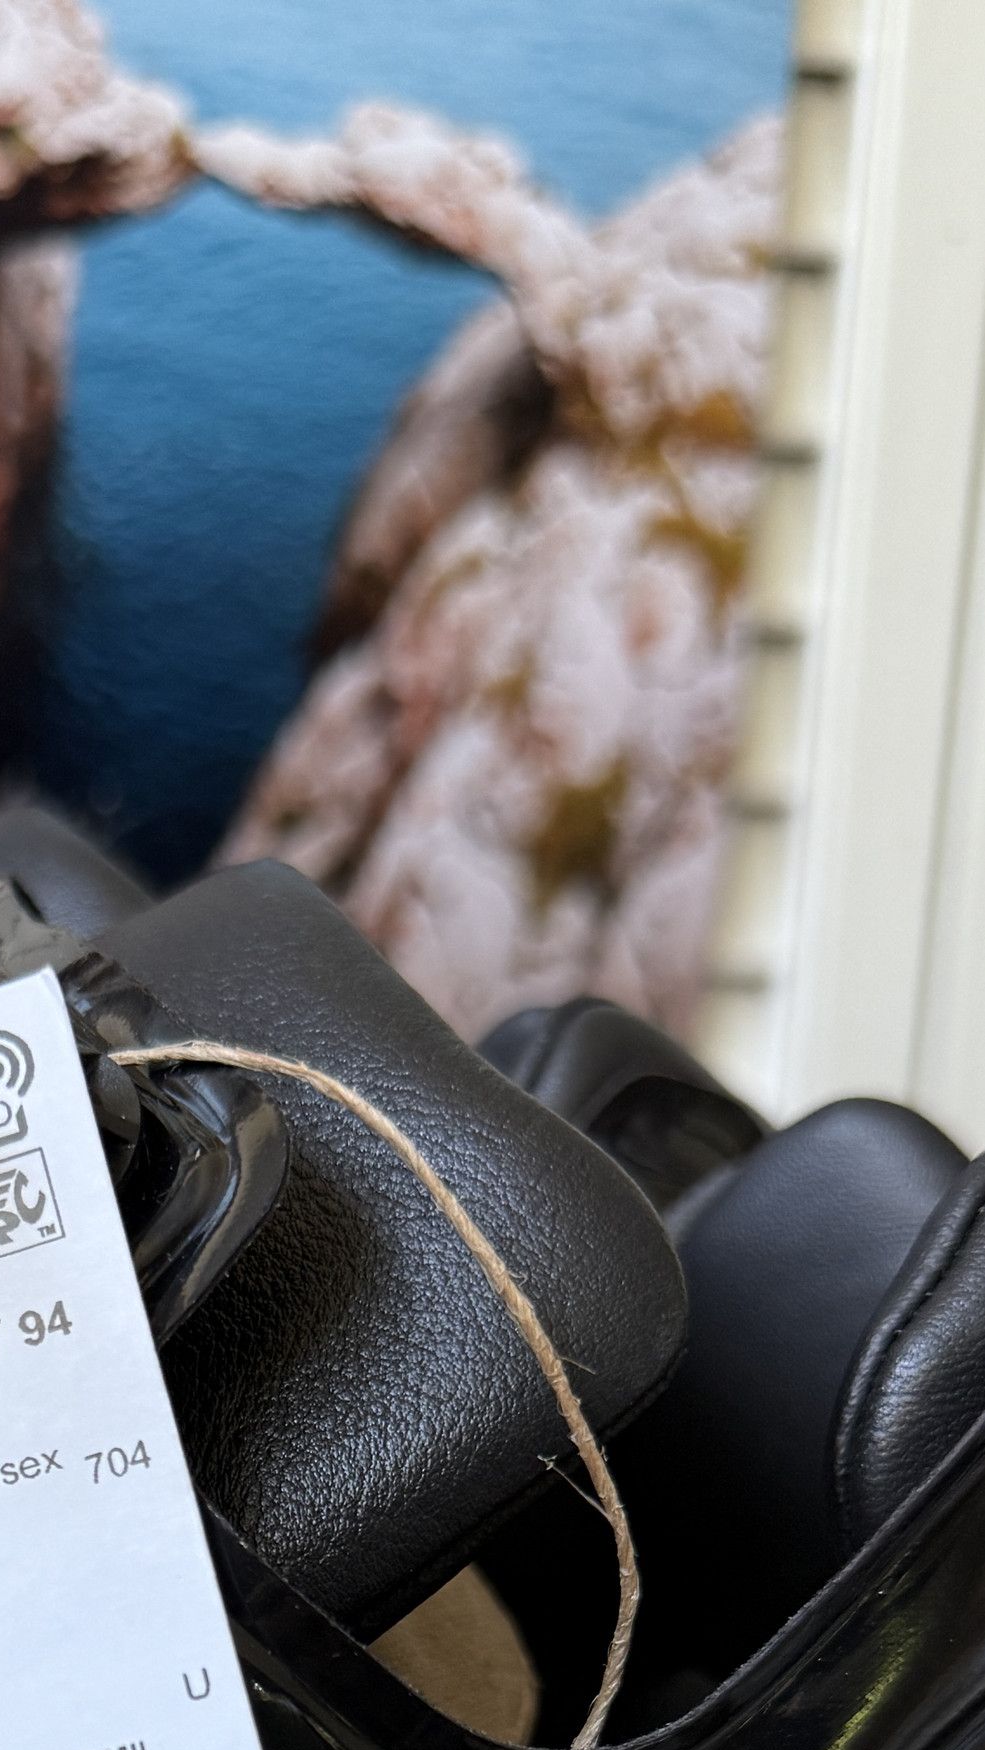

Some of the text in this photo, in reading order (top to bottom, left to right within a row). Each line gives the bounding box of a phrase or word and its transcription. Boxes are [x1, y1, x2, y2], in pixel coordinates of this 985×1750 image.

[17, 1300, 73, 1347] 94
[84, 1439, 152, 1485] 704
[182, 1667, 211, 1701] U
